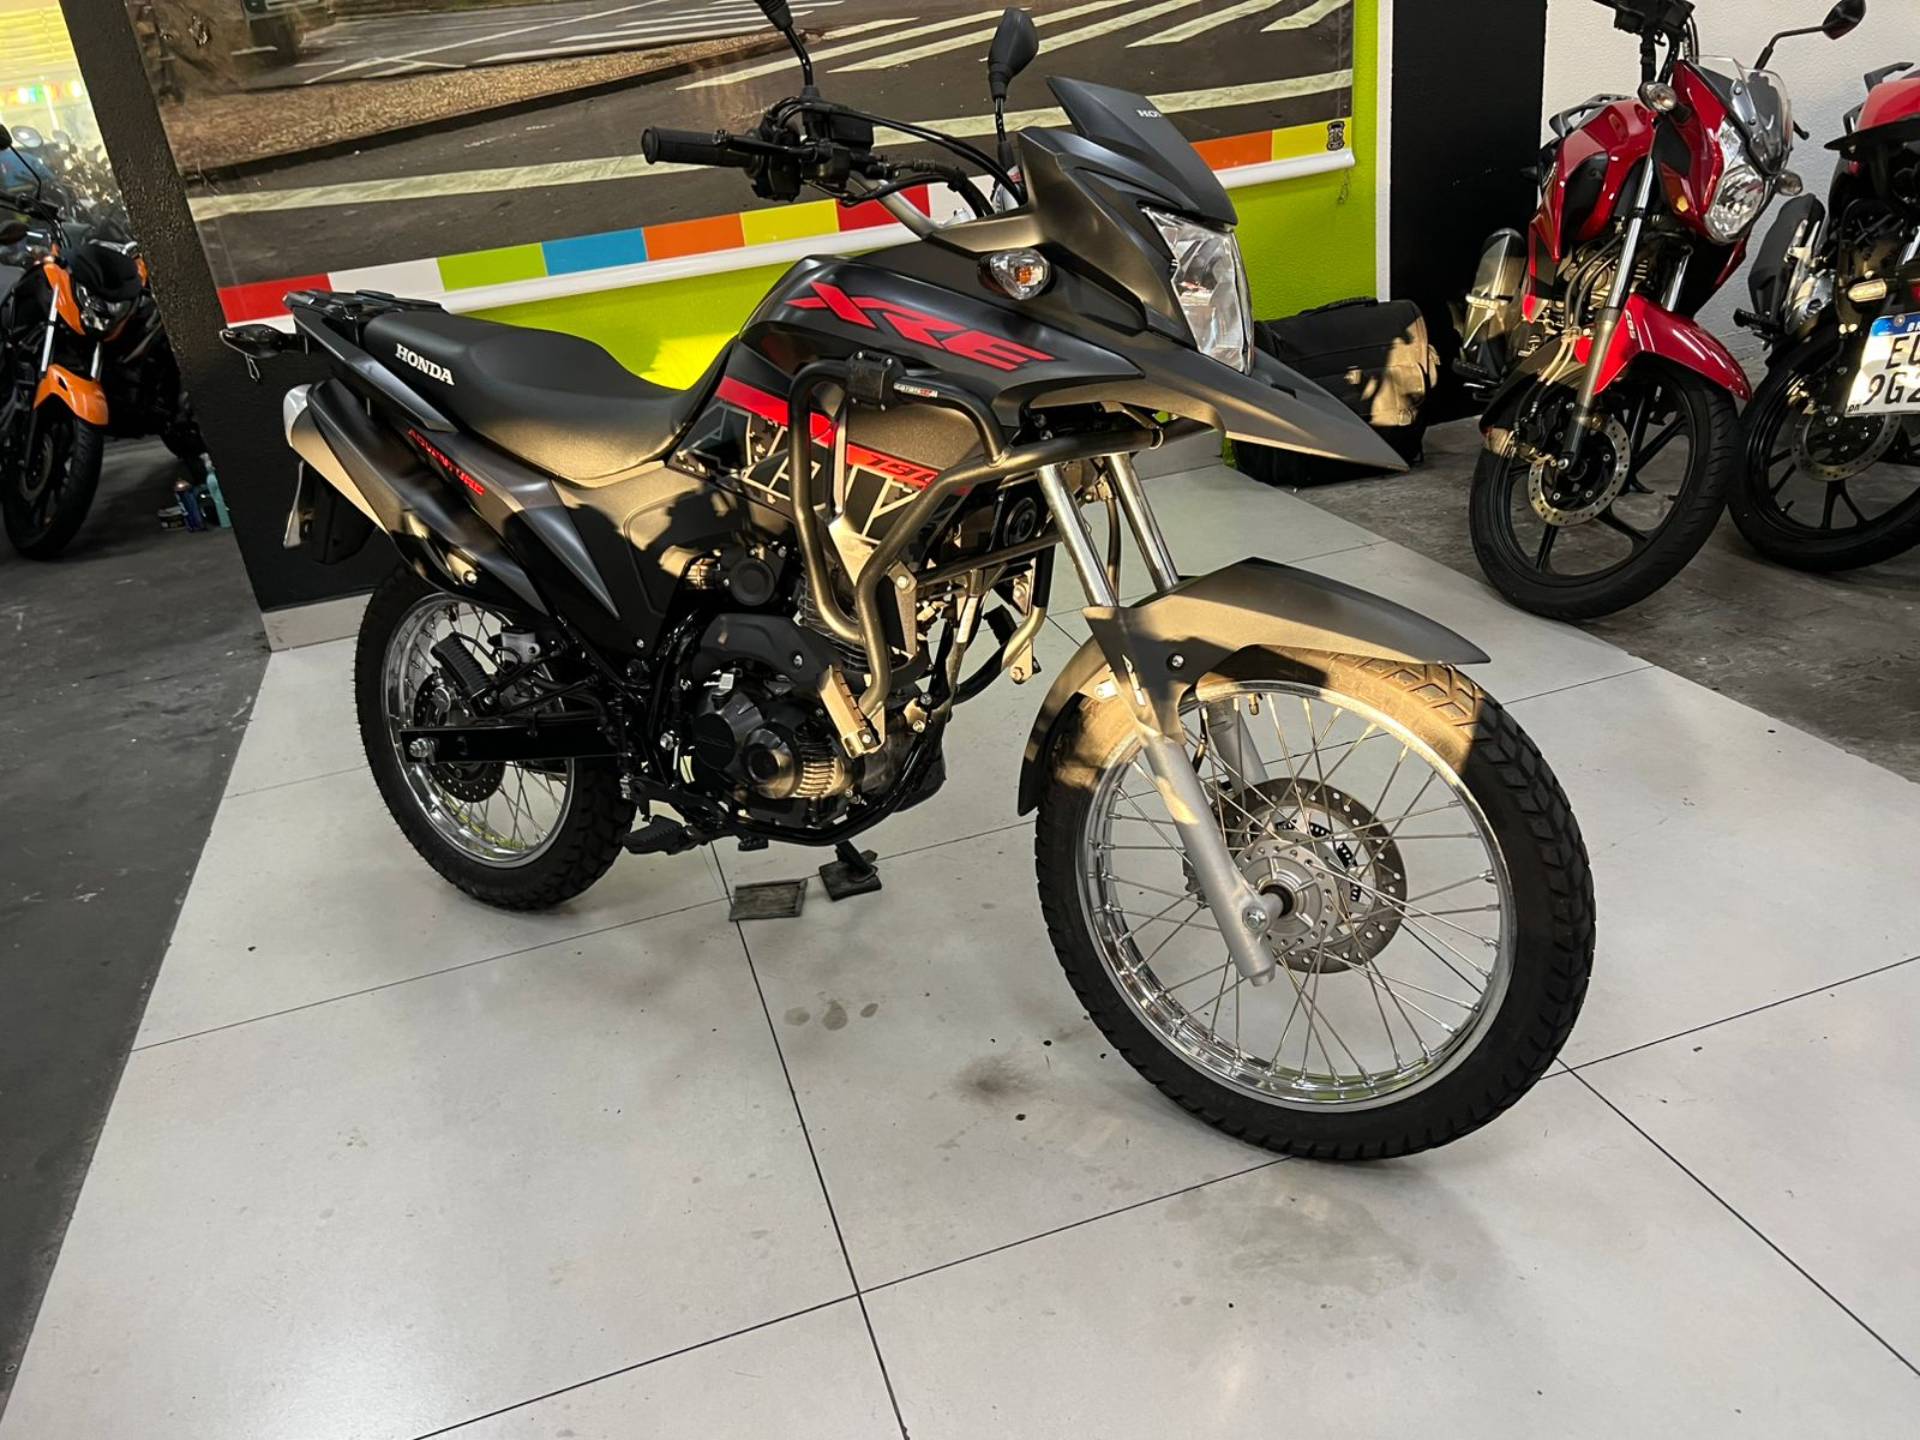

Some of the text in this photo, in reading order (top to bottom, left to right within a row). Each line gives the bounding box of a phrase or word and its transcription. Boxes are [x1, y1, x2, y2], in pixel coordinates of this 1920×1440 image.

[784, 281, 1056, 373] XRE
[395, 342, 456, 386] HONDA
[407, 428, 485, 496] ADVENTURE
